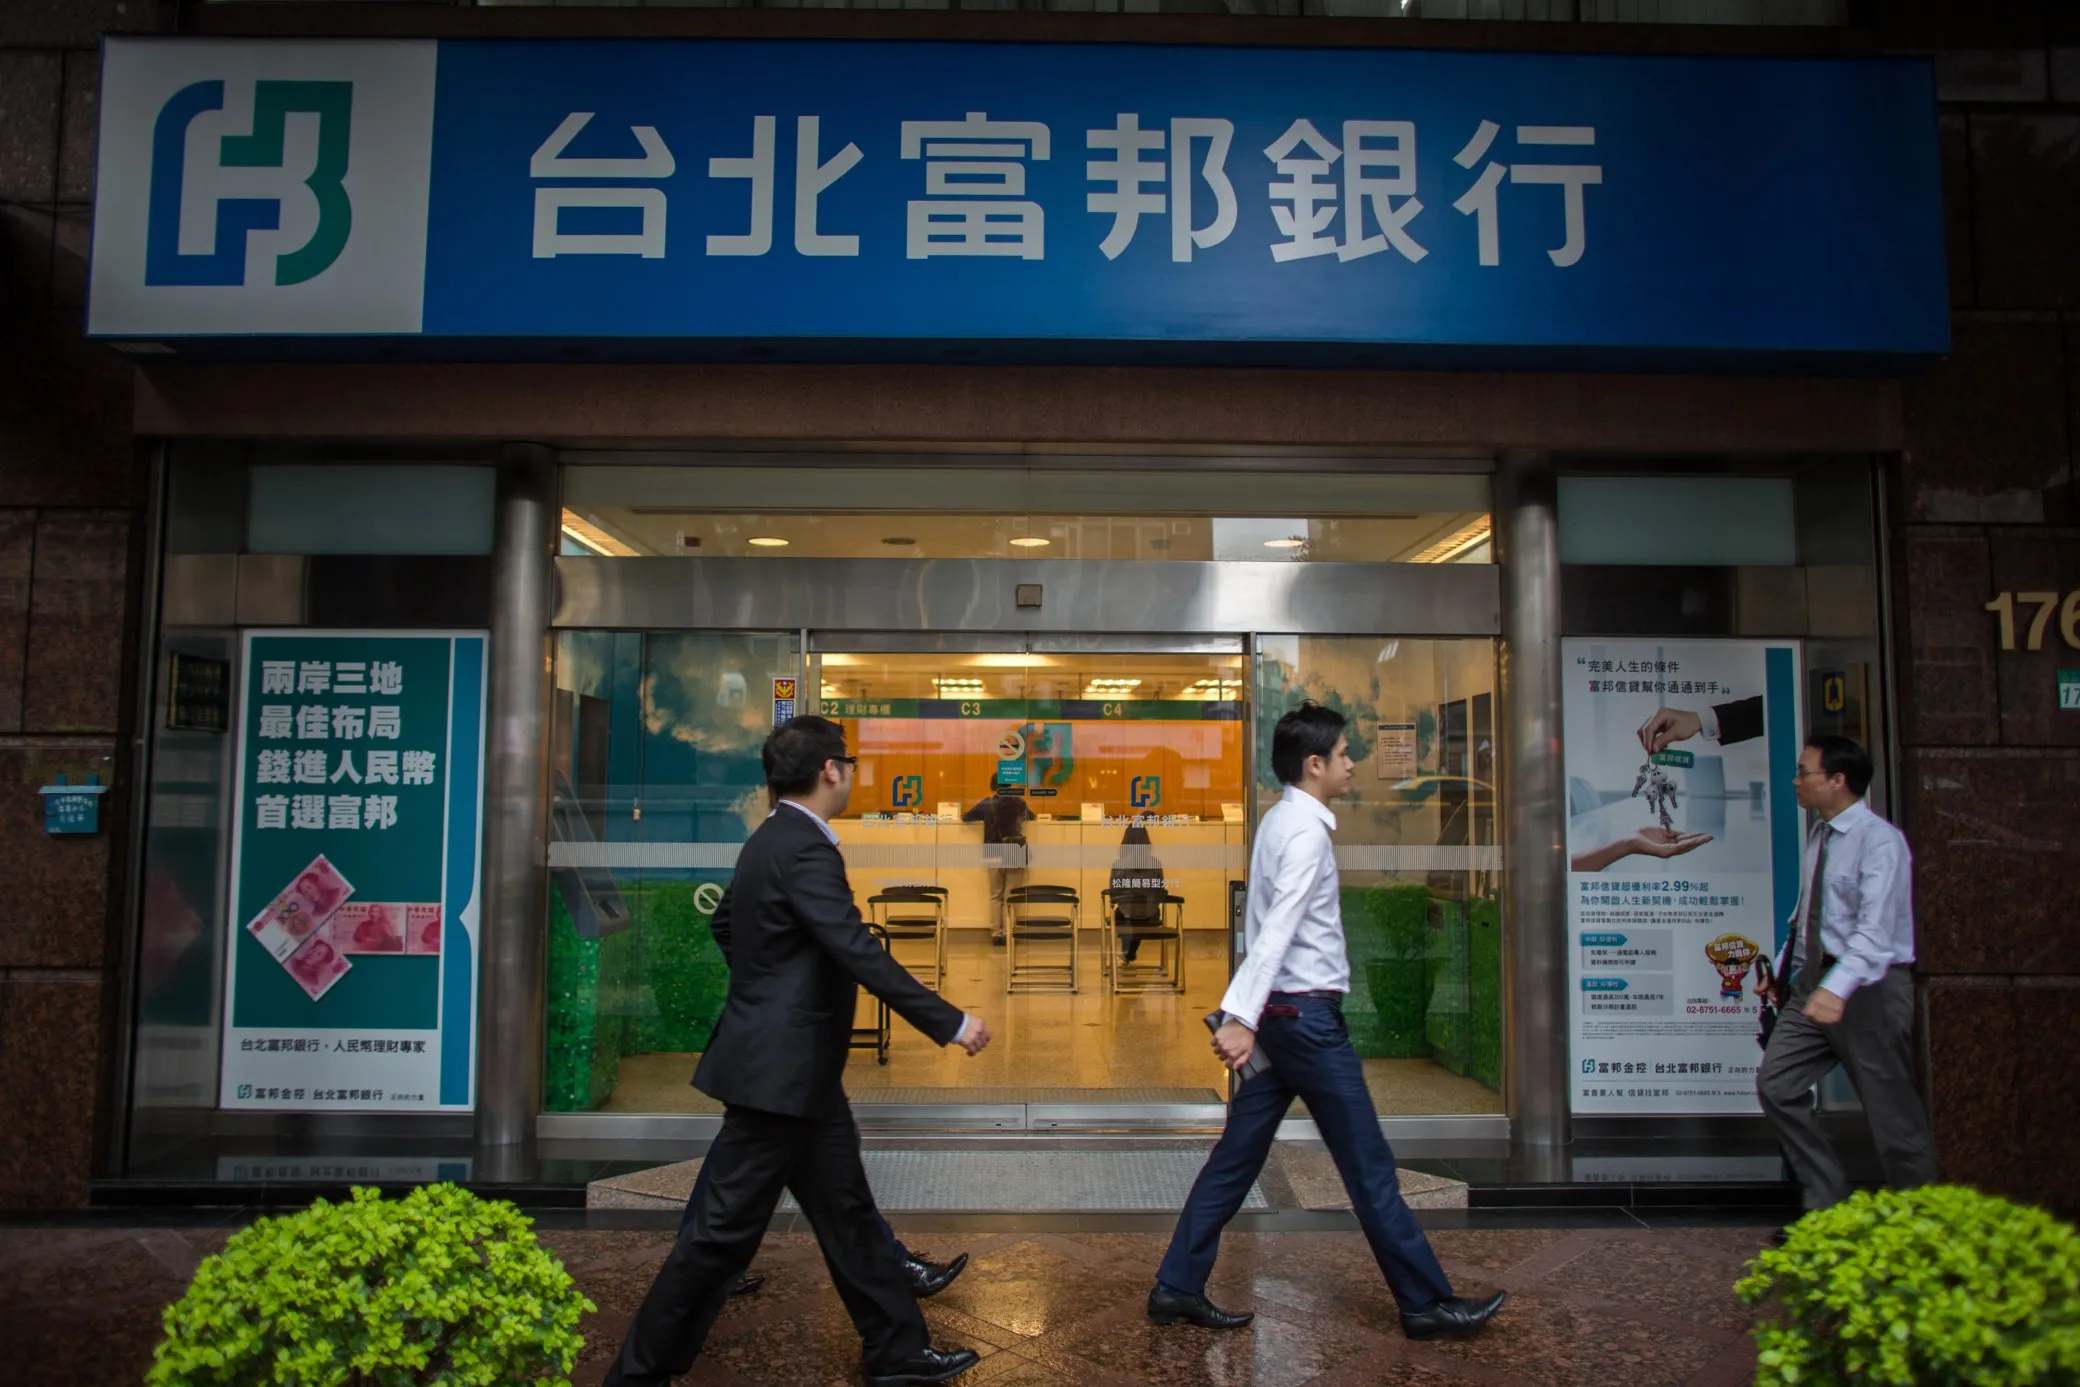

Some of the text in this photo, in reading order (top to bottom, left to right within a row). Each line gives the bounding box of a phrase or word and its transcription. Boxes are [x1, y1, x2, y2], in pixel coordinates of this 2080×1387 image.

[530, 111, 1603, 268] 台北富邦銀行
[261, 660, 404, 696] 兩岸三地
[821, 701, 892, 716] C2 理財專櫃
[961, 701, 982, 716] C3
[1103, 702, 1123, 717] C4
[259, 704, 402, 742] 最佳布局
[257, 749, 437, 786] 錢進人民幣
[255, 794, 398, 831] 首選富邦
[1112, 878, 1181, 889] 松隆簡易型分行
[1686, 1006, 1742, 1015] 02-8751-6665
[1598, 1061, 1648, 1075] 富邦金控
[1655, 1061, 1724, 1075] 台北富邦銀行
[254, 1087, 306, 1101] 富邦金控
[312, 1088, 385, 1102] 台北富邦銀行
